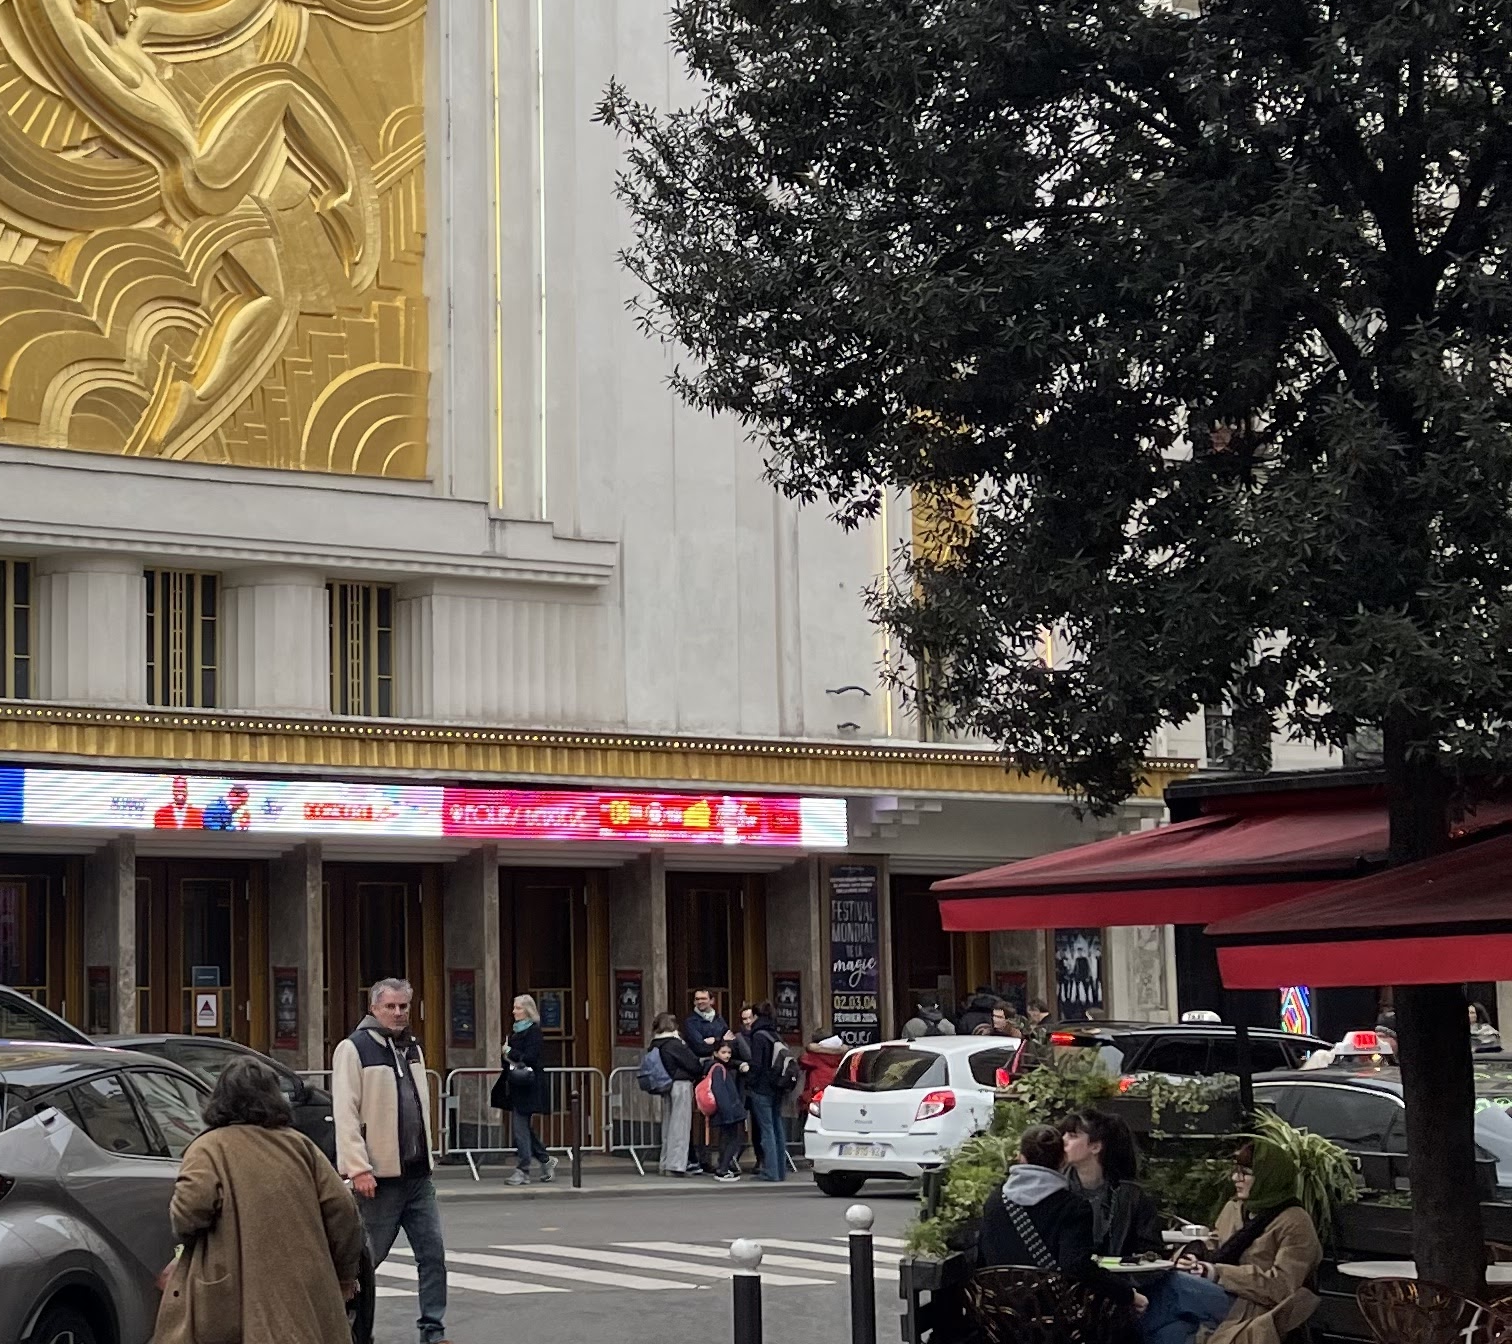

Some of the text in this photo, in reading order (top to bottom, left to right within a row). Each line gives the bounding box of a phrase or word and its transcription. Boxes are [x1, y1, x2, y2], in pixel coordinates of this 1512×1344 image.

[831, 900, 875, 922] FESTIVAL
[831, 922, 875, 943] MONDIAL
[833, 957, 877, 988] magie
